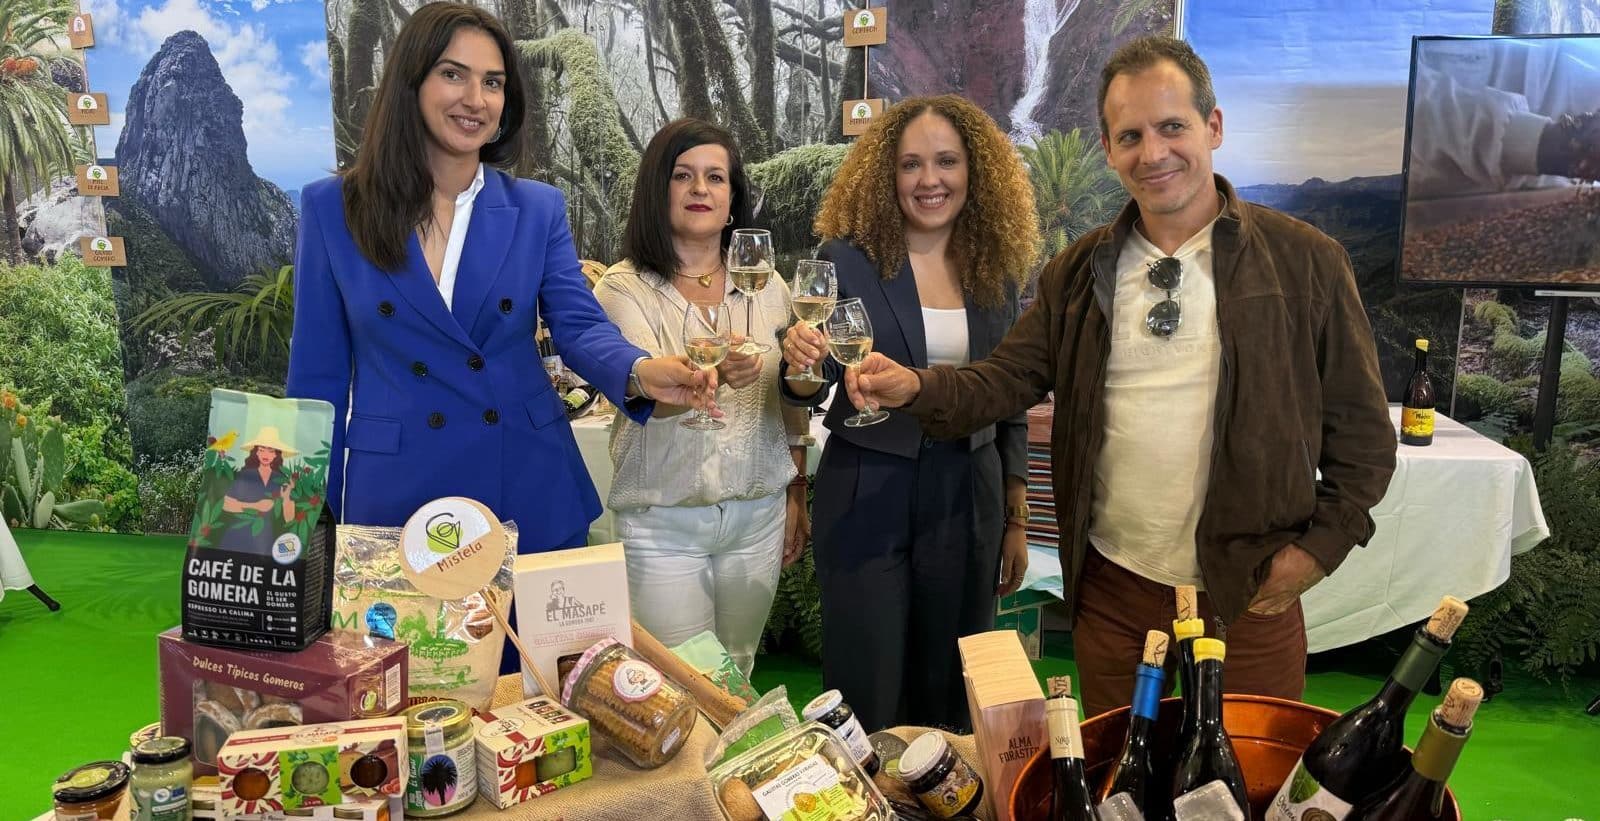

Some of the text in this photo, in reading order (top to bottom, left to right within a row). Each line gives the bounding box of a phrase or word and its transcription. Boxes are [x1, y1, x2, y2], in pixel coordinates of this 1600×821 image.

[436, 542, 483, 572] Mistela
[188, 558, 296, 587] CAFÉ DE LA
[188, 579, 259, 605] GOMERA
[188, 603, 217, 613] ESPRESSO
[546, 601, 606, 622] EL MASAPÉ
[192, 655, 305, 691] Dulces Típicos Gomeros
[1008, 736, 1032, 750] ALMA
